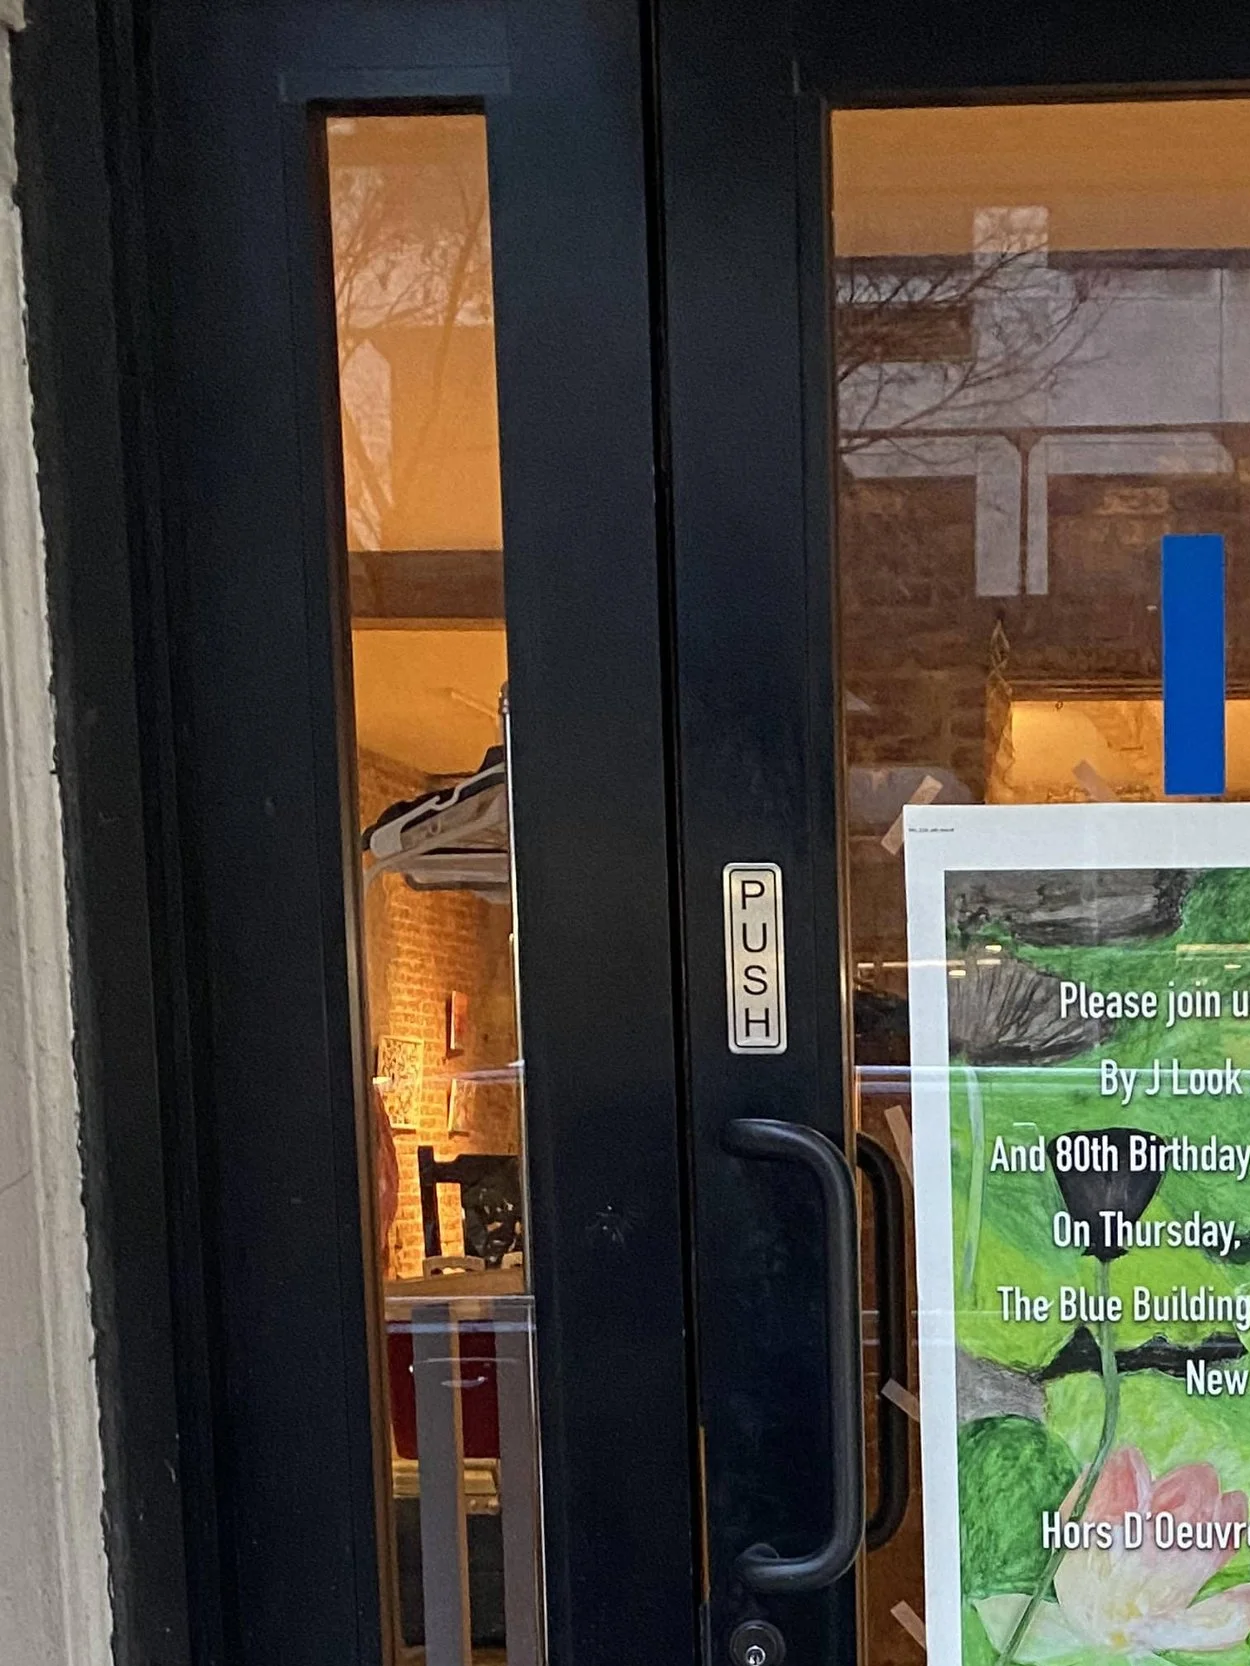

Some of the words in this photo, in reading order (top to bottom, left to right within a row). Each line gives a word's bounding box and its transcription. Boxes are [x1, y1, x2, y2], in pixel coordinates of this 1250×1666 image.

[741, 879, 770, 1037] PUSH
[1060, 981, 1157, 1019] Please
[1166, 981, 1221, 1028] join
[1101, 1059, 1137, 1105] By
[1145, 1059, 1160, 1095] J
[1172, 1058, 1243, 1095] Look
[990, 1135, 1046, 1172] And
[1056, 1135, 1118, 1172] 80th
[1053, 1210, 1090, 1247] On
[1099, 1210, 1242, 1256] Thursday,
[997, 1286, 1049, 1322] The
[1060, 1286, 1122, 1322] Blue
[1186, 1360, 1248, 1395] New
[1042, 1511, 1113, 1549] Hors
